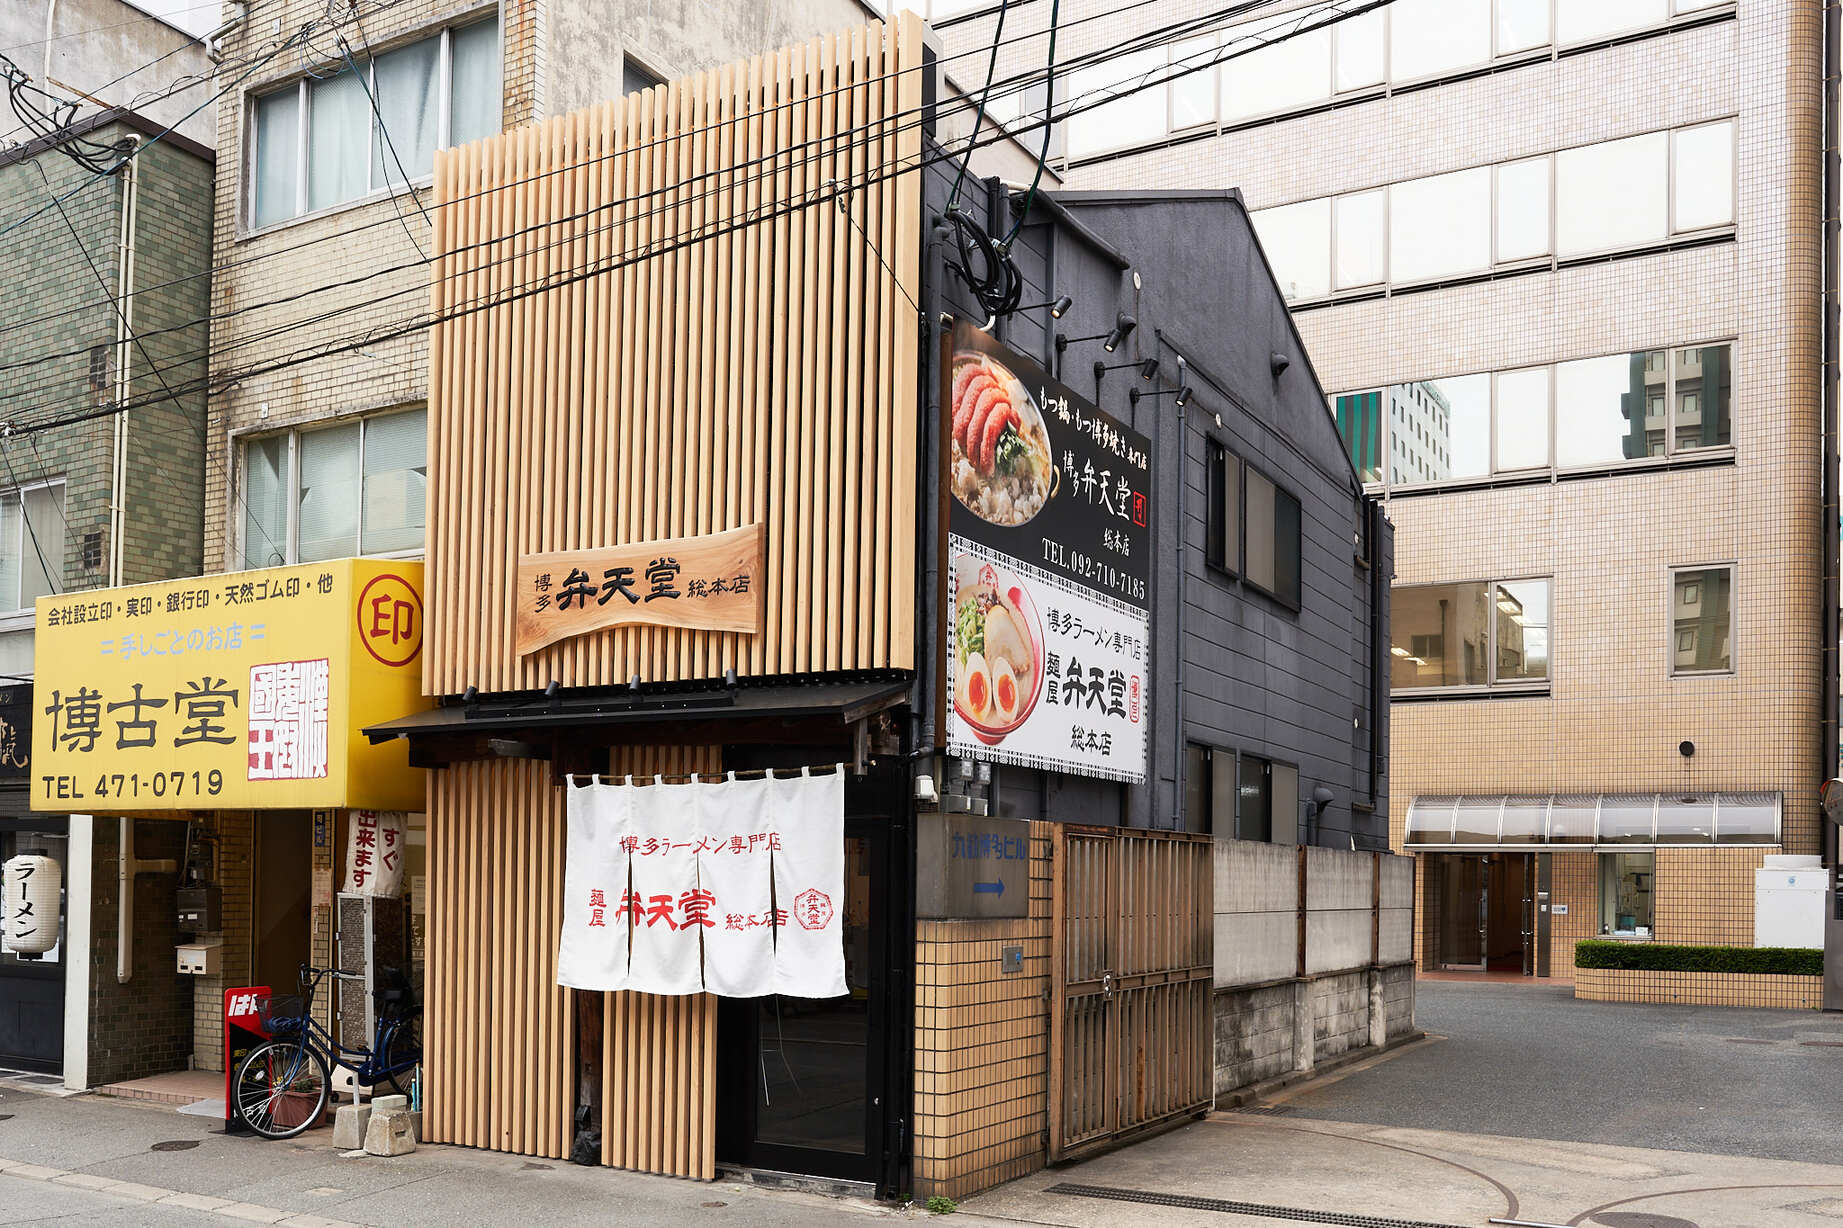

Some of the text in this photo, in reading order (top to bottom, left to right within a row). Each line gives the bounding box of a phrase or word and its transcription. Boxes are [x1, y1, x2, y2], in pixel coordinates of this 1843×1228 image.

[1063, 450, 1080, 498] 博多
[1080, 458, 1133, 521] 弁天堂
[1103, 528, 1130, 557] 総本店
[47, 573, 333, 627] 会社設立印・実印・銀行印・天然ゴム印・他
[535, 557, 751, 613] 博多 弁天堂 総本店
[369, 594, 414, 646] 印
[1062, 656, 1127, 720] 弁天堂
[45, 677, 239, 753] 博古堂
[1070, 724, 1112, 756] 総本店
[42, 769, 223, 799] TEL 471-0719
[353, 809, 377, 888] 出来ます
[383, 828, 399, 871] すぐ
[619, 832, 782, 856] 博多ラーメン専門店
[14, 863, 37, 938] ラーメン
[615, 888, 717, 932] 弁天堂
[725, 908, 789, 931] 総本店
